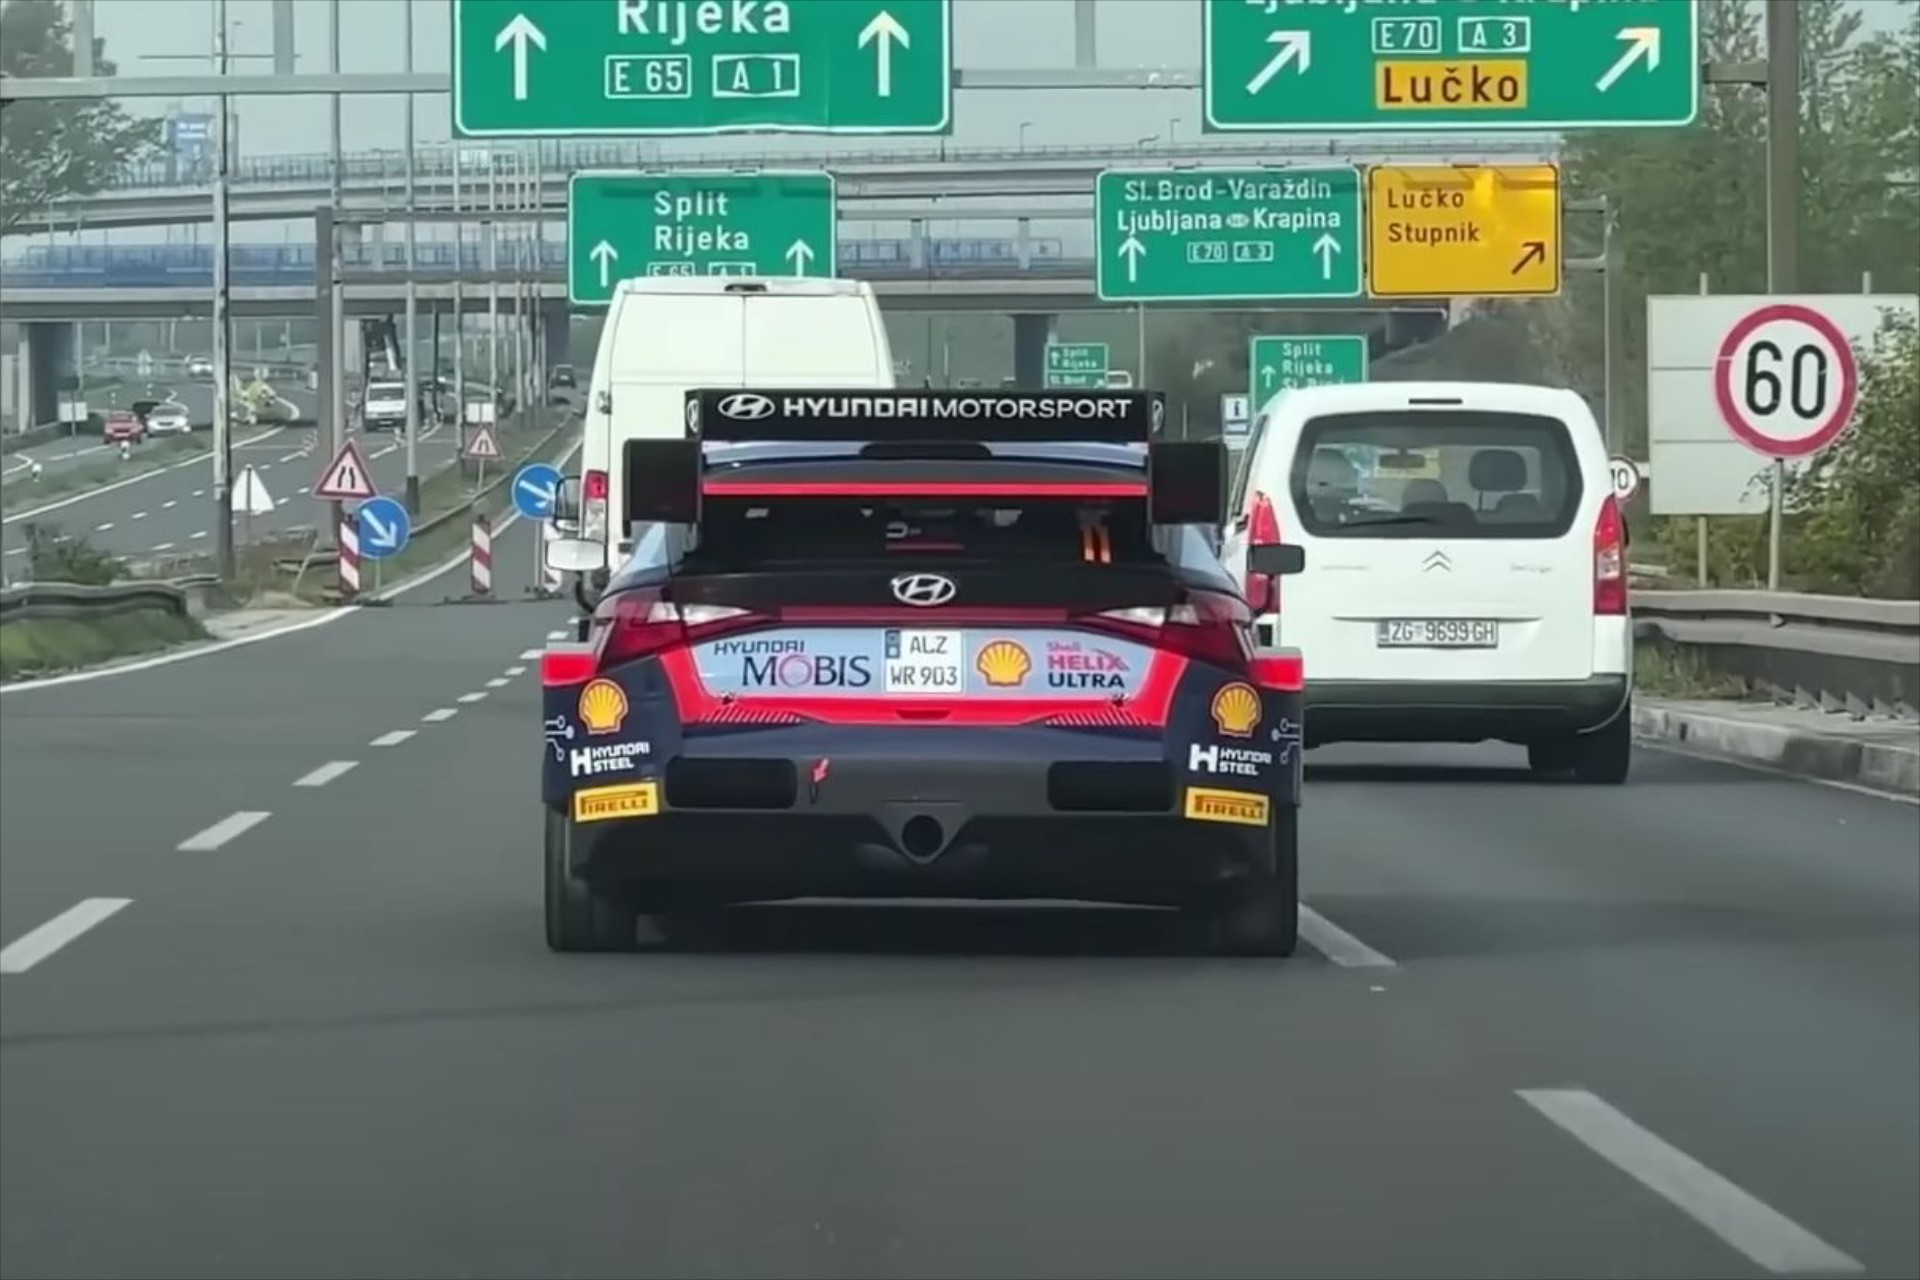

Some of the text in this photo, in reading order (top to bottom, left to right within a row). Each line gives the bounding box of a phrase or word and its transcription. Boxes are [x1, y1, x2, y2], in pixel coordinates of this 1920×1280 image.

[618, 0, 790, 45] Rijeka
[1381, 22, 1433, 48] E 70
[1472, 23, 1516, 47] A 3
[615, 61, 683, 92] E 65
[732, 61, 781, 91] A 1
[1384, 65, 1519, 103] Lučko
[654, 190, 728, 222] Split
[1388, 187, 1464, 208] Lučko
[1117, 209, 1222, 235] Ljubljana
[1253, 207, 1341, 233] Krapina
[654, 224, 748, 257] Rijeka
[1388, 222, 1479, 247] Stupnik
[1282, 342, 1321, 359] Split
[1282, 360, 1333, 377] Rijeka
[1746, 340, 1827, 419] 60
[783, 397, 1132, 419] HYUNDAI MOTORSPORT
[1392, 622, 1413, 641] ZG
[714, 640, 805, 655] HYUNDAI
[909, 635, 948, 655] ALZ
[742, 655, 872, 687] MOBIS
[1048, 655, 1130, 672] HELIX
[890, 666, 957, 686] WR 903
[1048, 672, 1125, 688] ULTRA
[592, 742, 650, 758] HYUNDAI
[593, 757, 634, 772] STEEL
[1219, 761, 1259, 775] STEEL
[581, 790, 648, 815] PIRELLI
